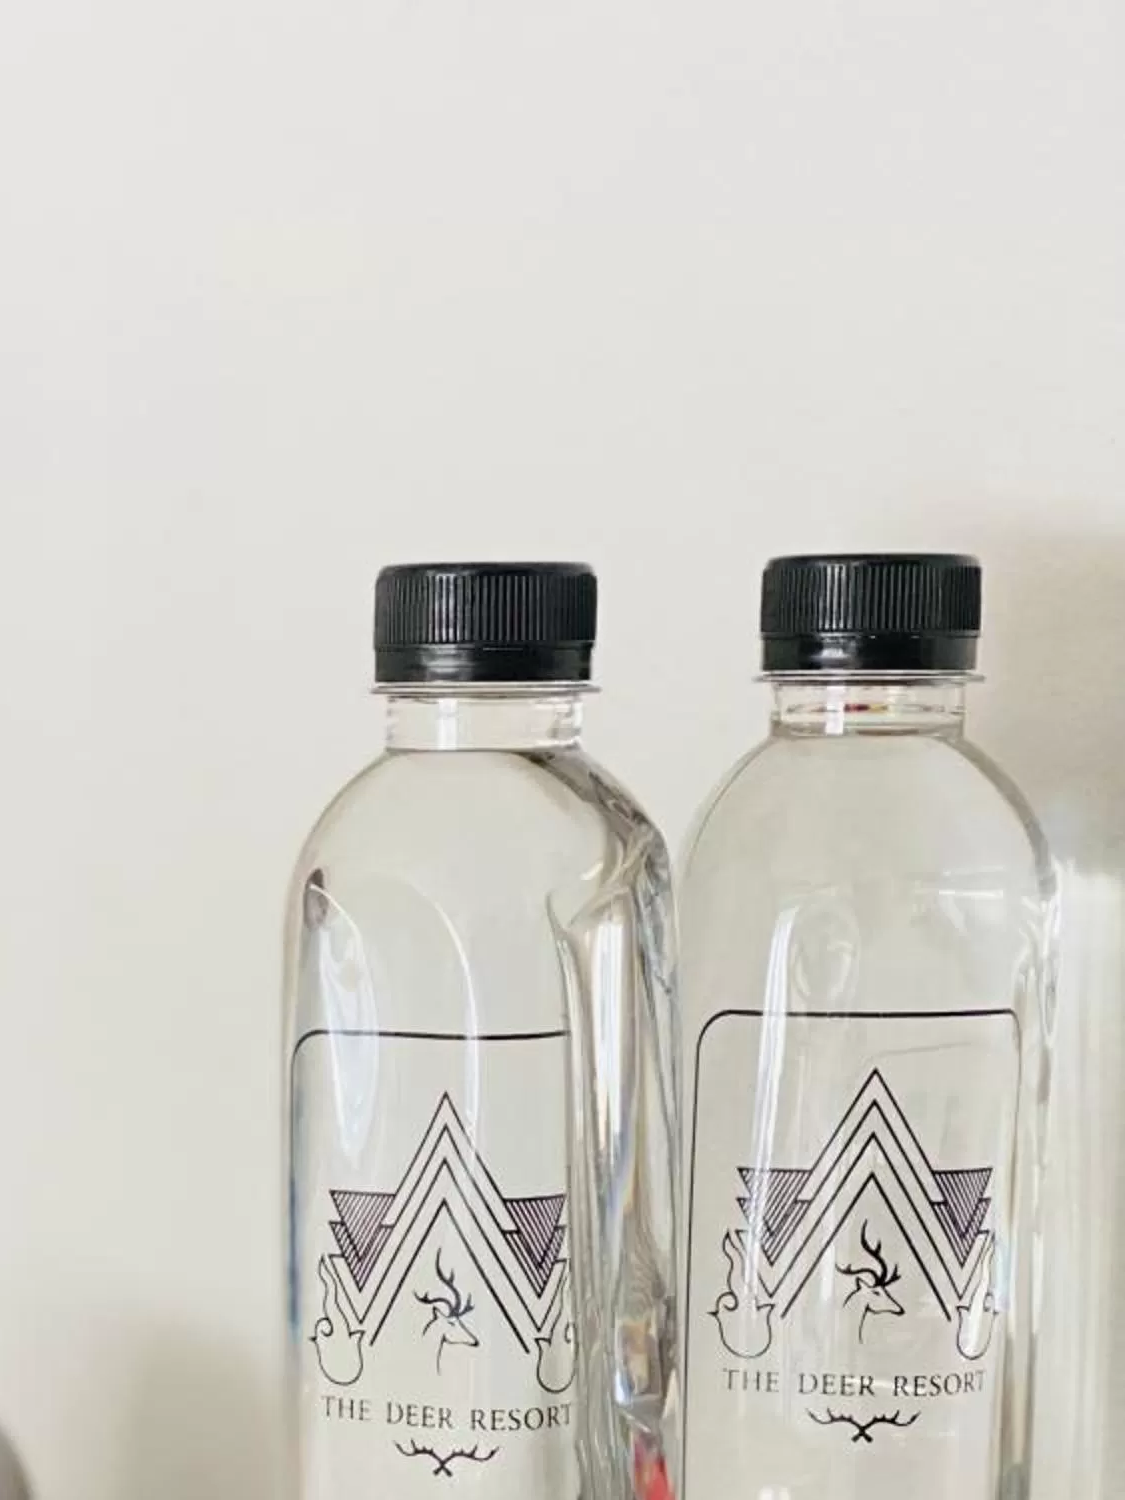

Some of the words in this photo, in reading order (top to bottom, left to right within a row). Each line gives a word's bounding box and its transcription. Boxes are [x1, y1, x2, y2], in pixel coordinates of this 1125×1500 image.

[722, 1367, 780, 1393] THE
[798, 1372, 876, 1397] DEER
[892, 1369, 988, 1398] RESORT
[321, 1395, 372, 1422] THE
[386, 1400, 455, 1430] DEER
[470, 1402, 573, 1432] RESORT
